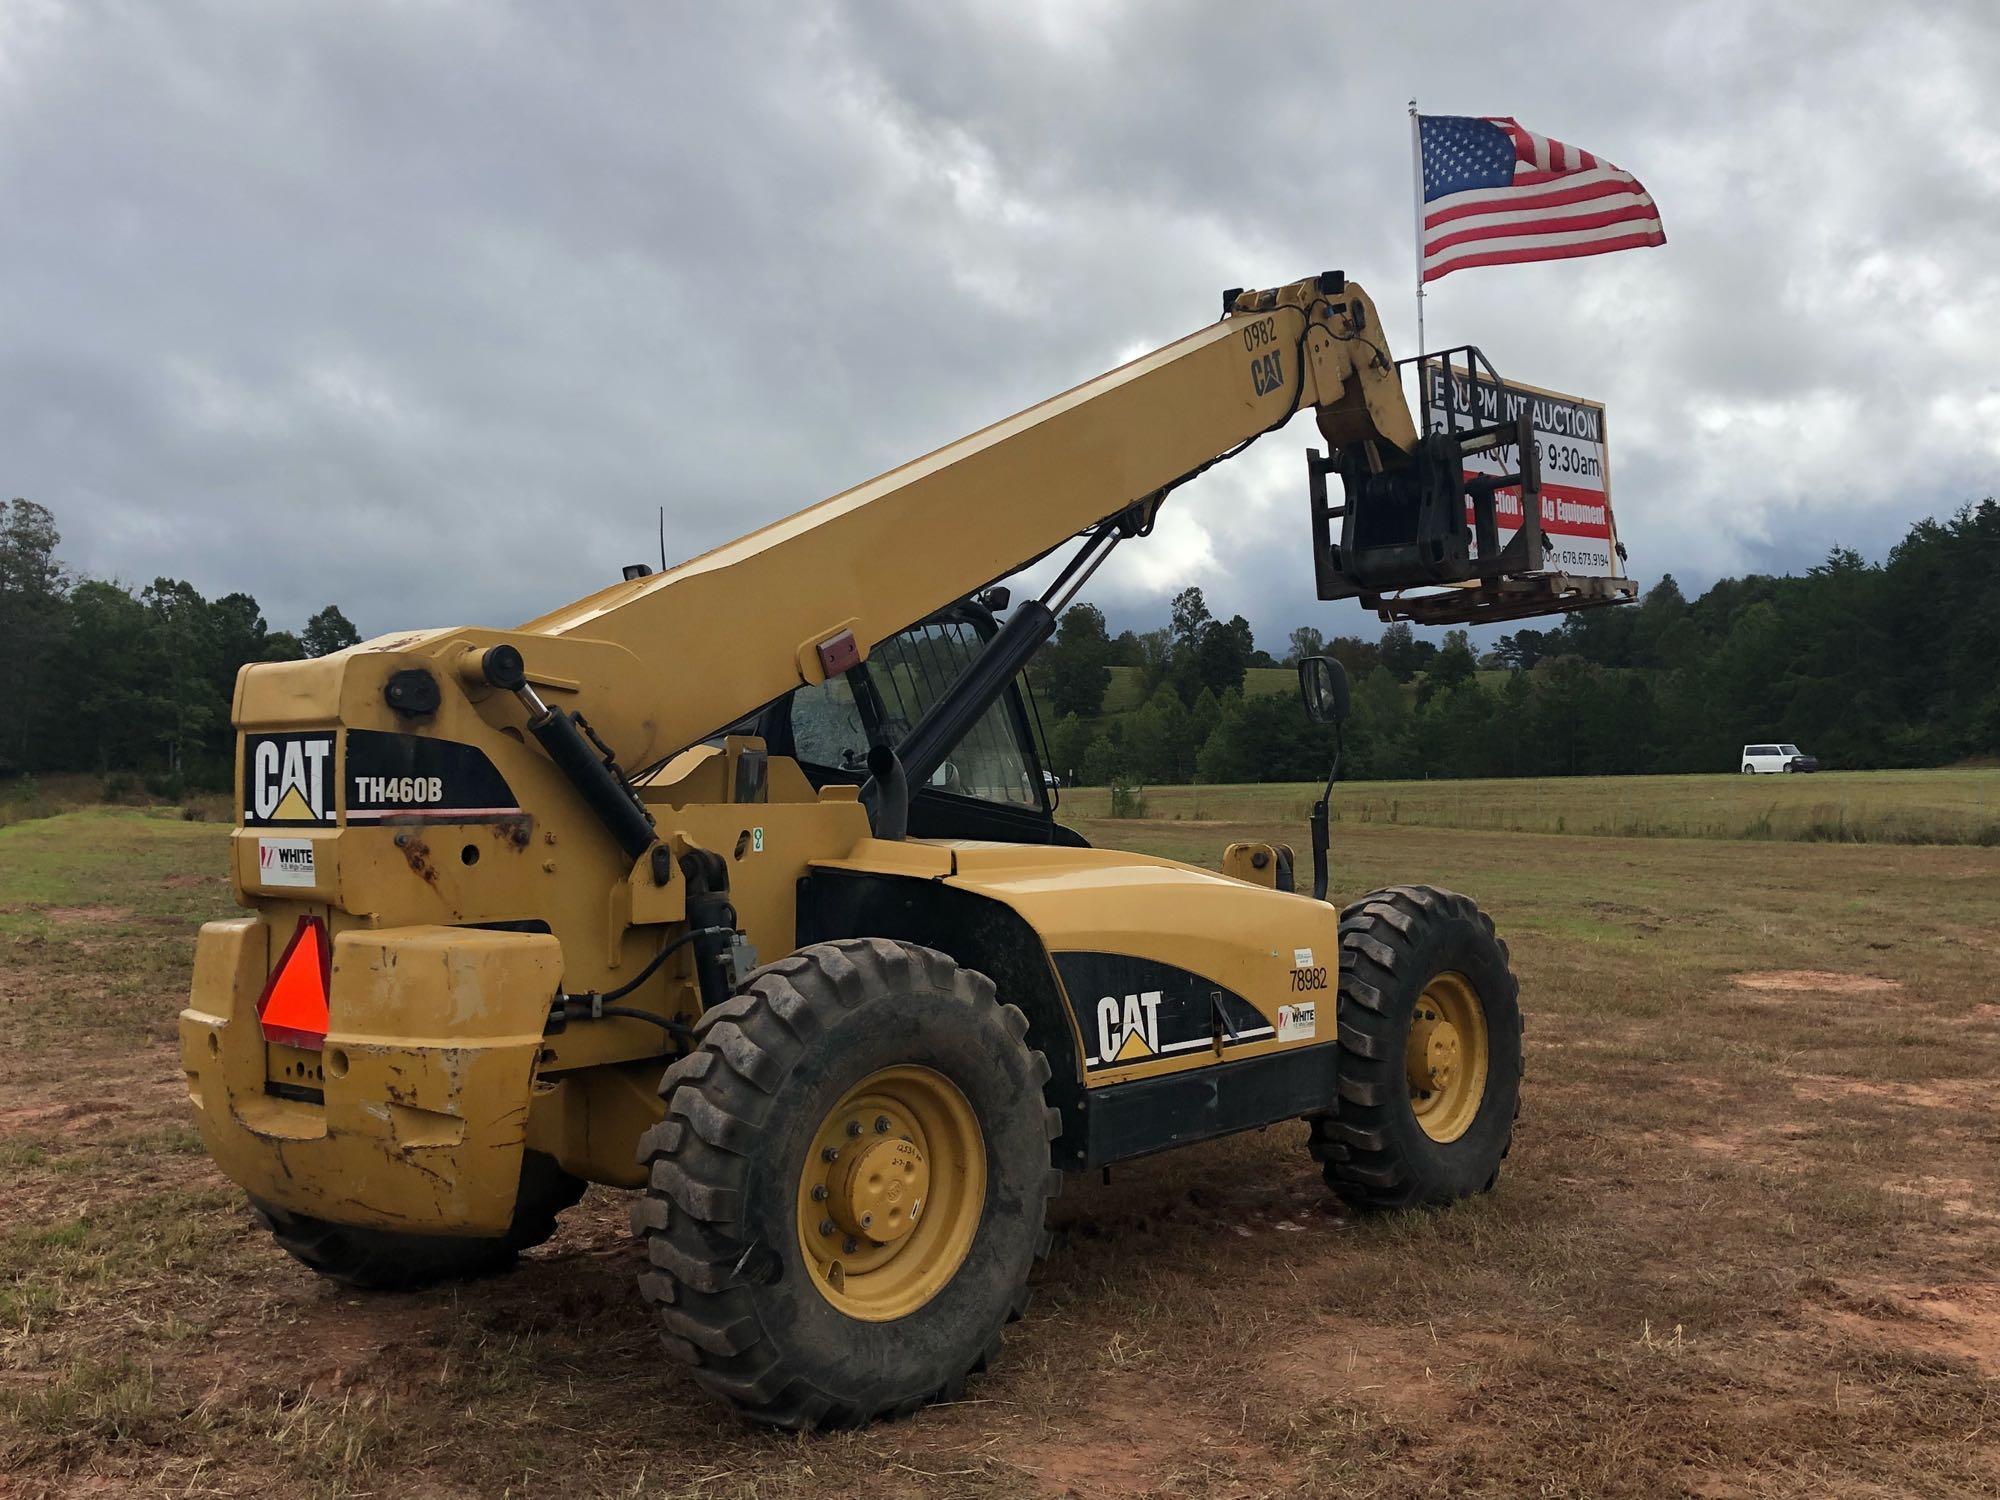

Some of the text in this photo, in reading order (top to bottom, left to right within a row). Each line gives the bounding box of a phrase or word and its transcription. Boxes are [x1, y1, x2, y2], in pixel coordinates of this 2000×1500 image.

[1243, 317, 1277, 352] 0982
[1251, 349, 1284, 397] CAT
[1532, 400, 1598, 439] AUCTION
[1548, 444, 1600, 477] 9:30am
[1541, 496, 1555, 521] Ag
[1556, 498, 1606, 525] Equipment
[255, 740, 329, 820] CAT
[355, 777, 443, 803] TH460B
[278, 848, 313, 864] WHITE
[1290, 967, 1328, 992] 78982
[1097, 991, 1162, 1063] CAT
[1292, 1009, 1315, 1023] WHITE
